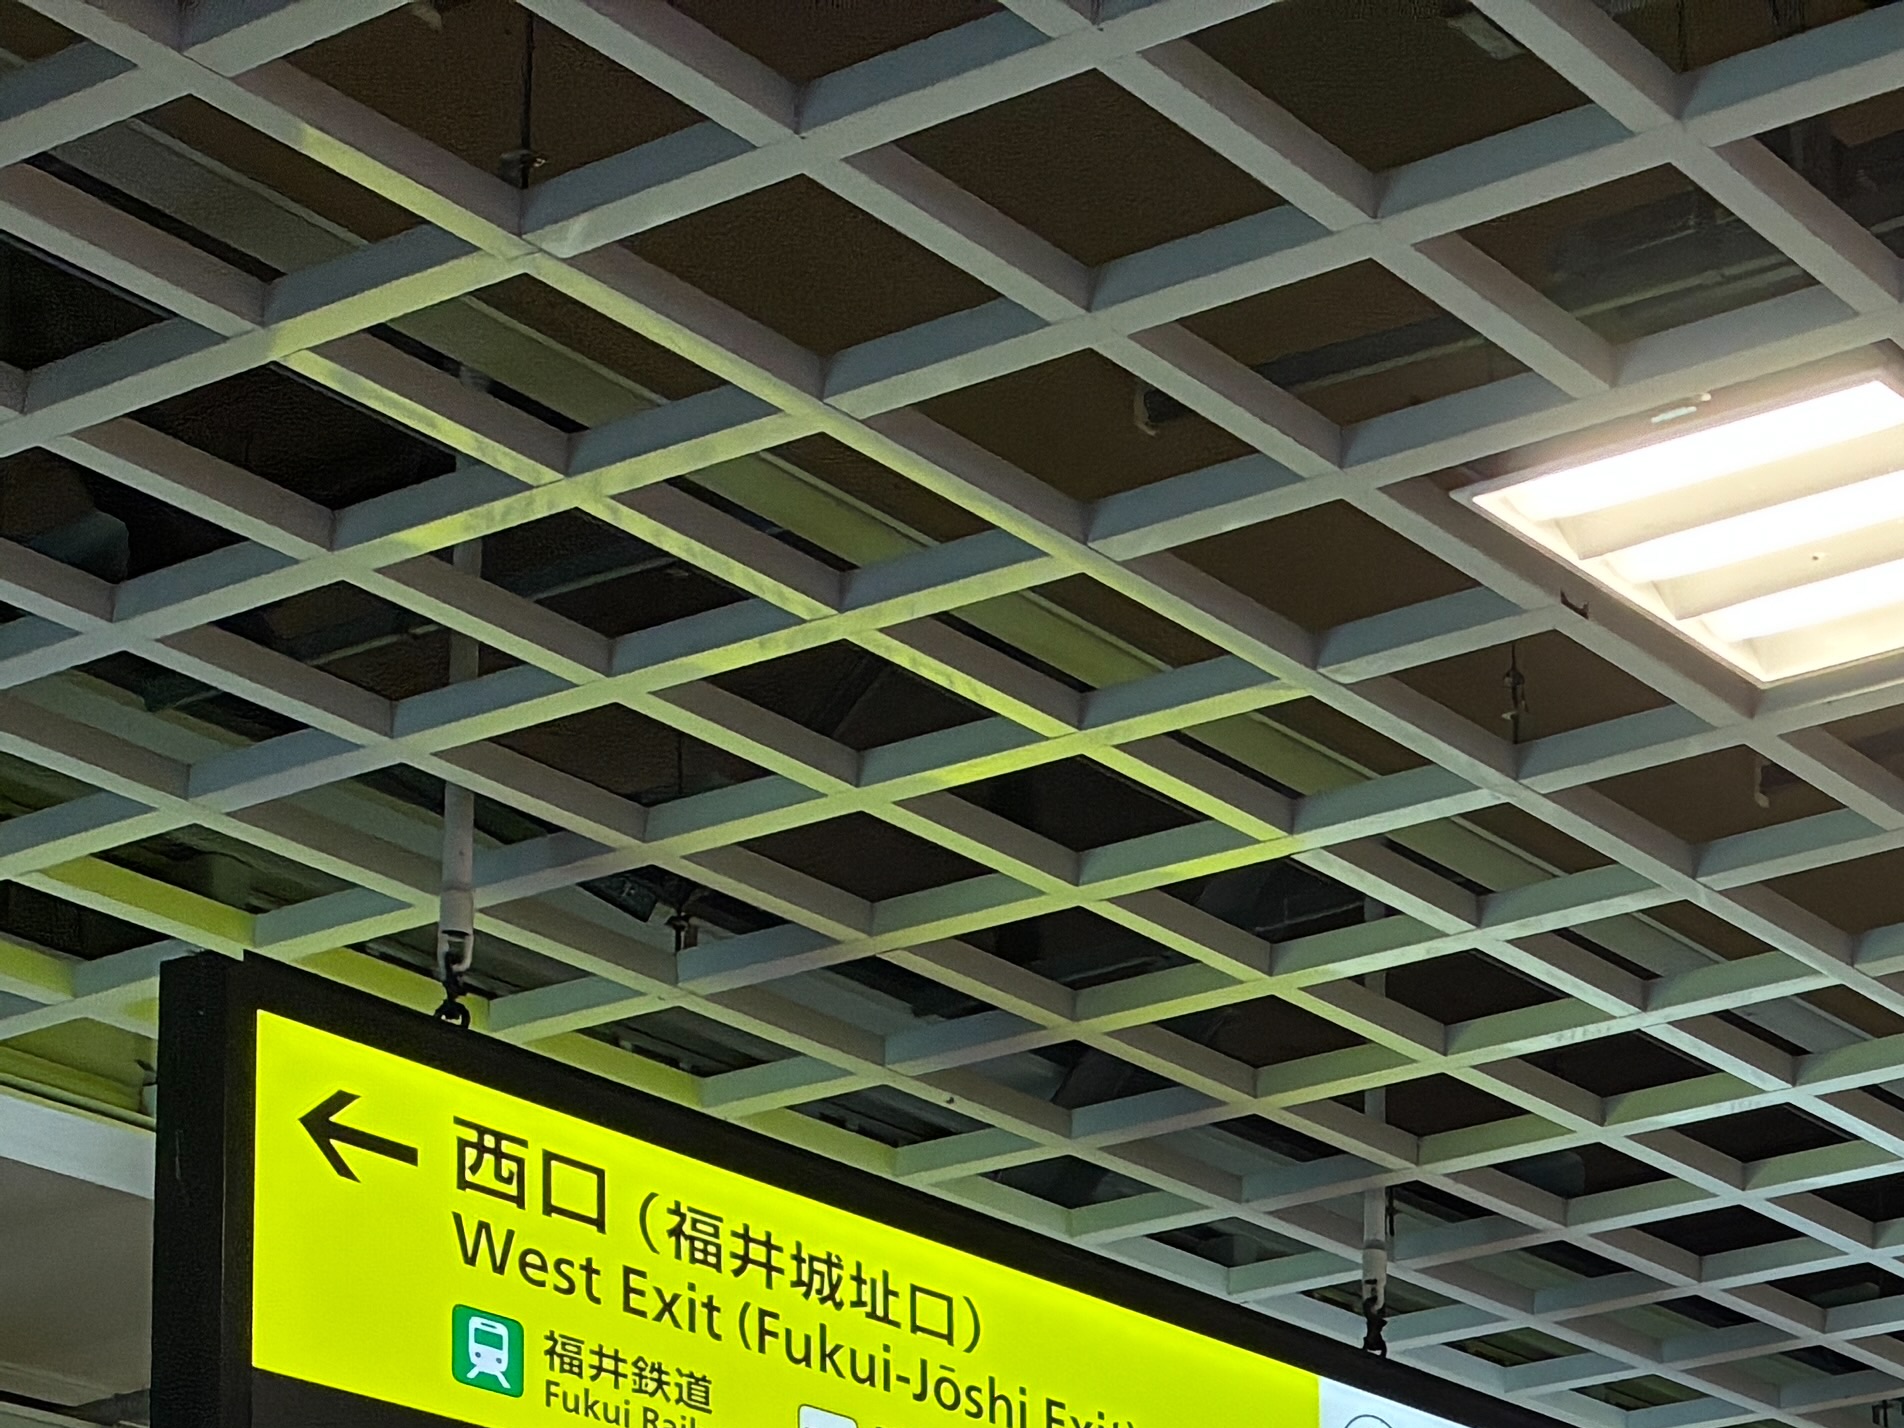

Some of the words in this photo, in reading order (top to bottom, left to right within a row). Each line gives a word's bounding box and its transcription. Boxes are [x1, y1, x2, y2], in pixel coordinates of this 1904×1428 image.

[452, 1211, 601, 1306] West
[622, 1265, 722, 1342] Exit
[544, 1330, 713, 1414] 福井鉄道
[545, 1380, 630, 1428] Fukui
